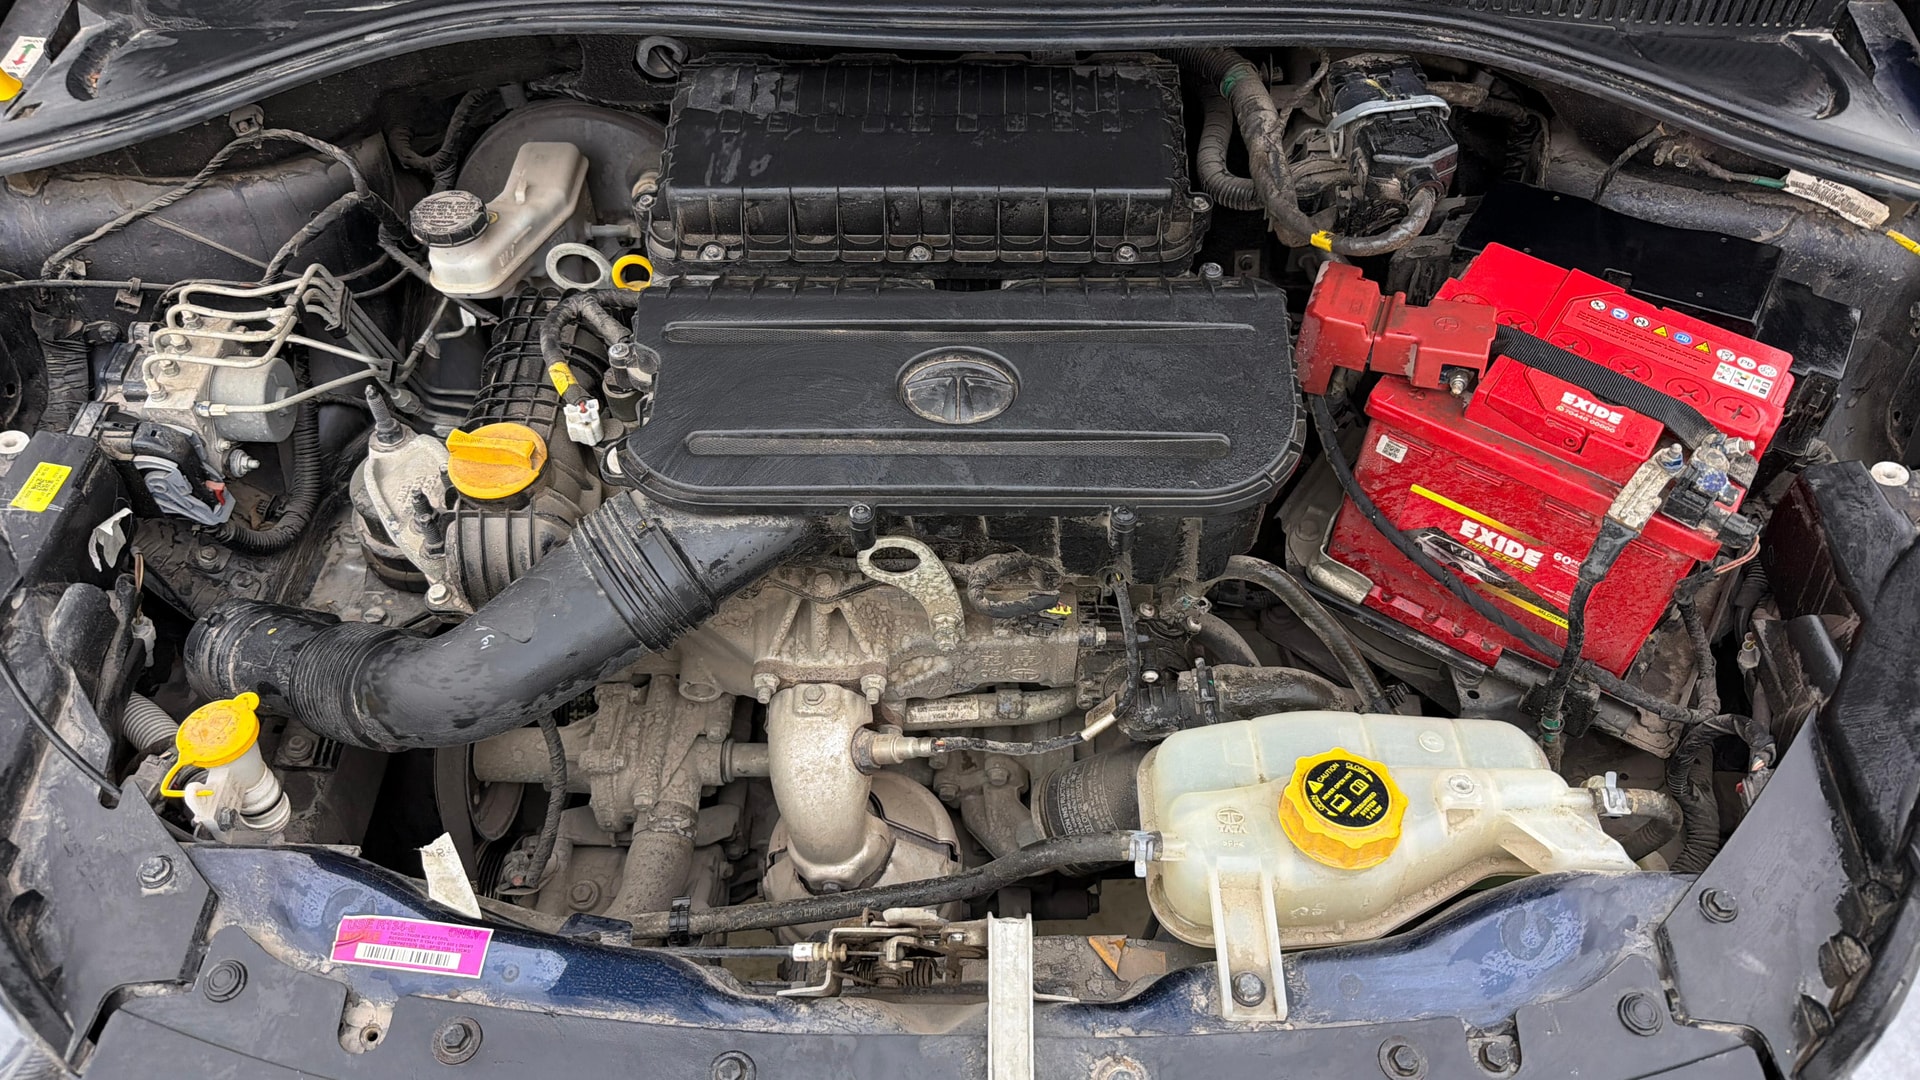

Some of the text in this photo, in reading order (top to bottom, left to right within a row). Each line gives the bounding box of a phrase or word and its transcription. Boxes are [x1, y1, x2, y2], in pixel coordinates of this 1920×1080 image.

[1561, 391, 1624, 425] EXIDE
[1459, 519, 1544, 568] EXIDE
[1317, 762, 1340, 782] CAUTION
